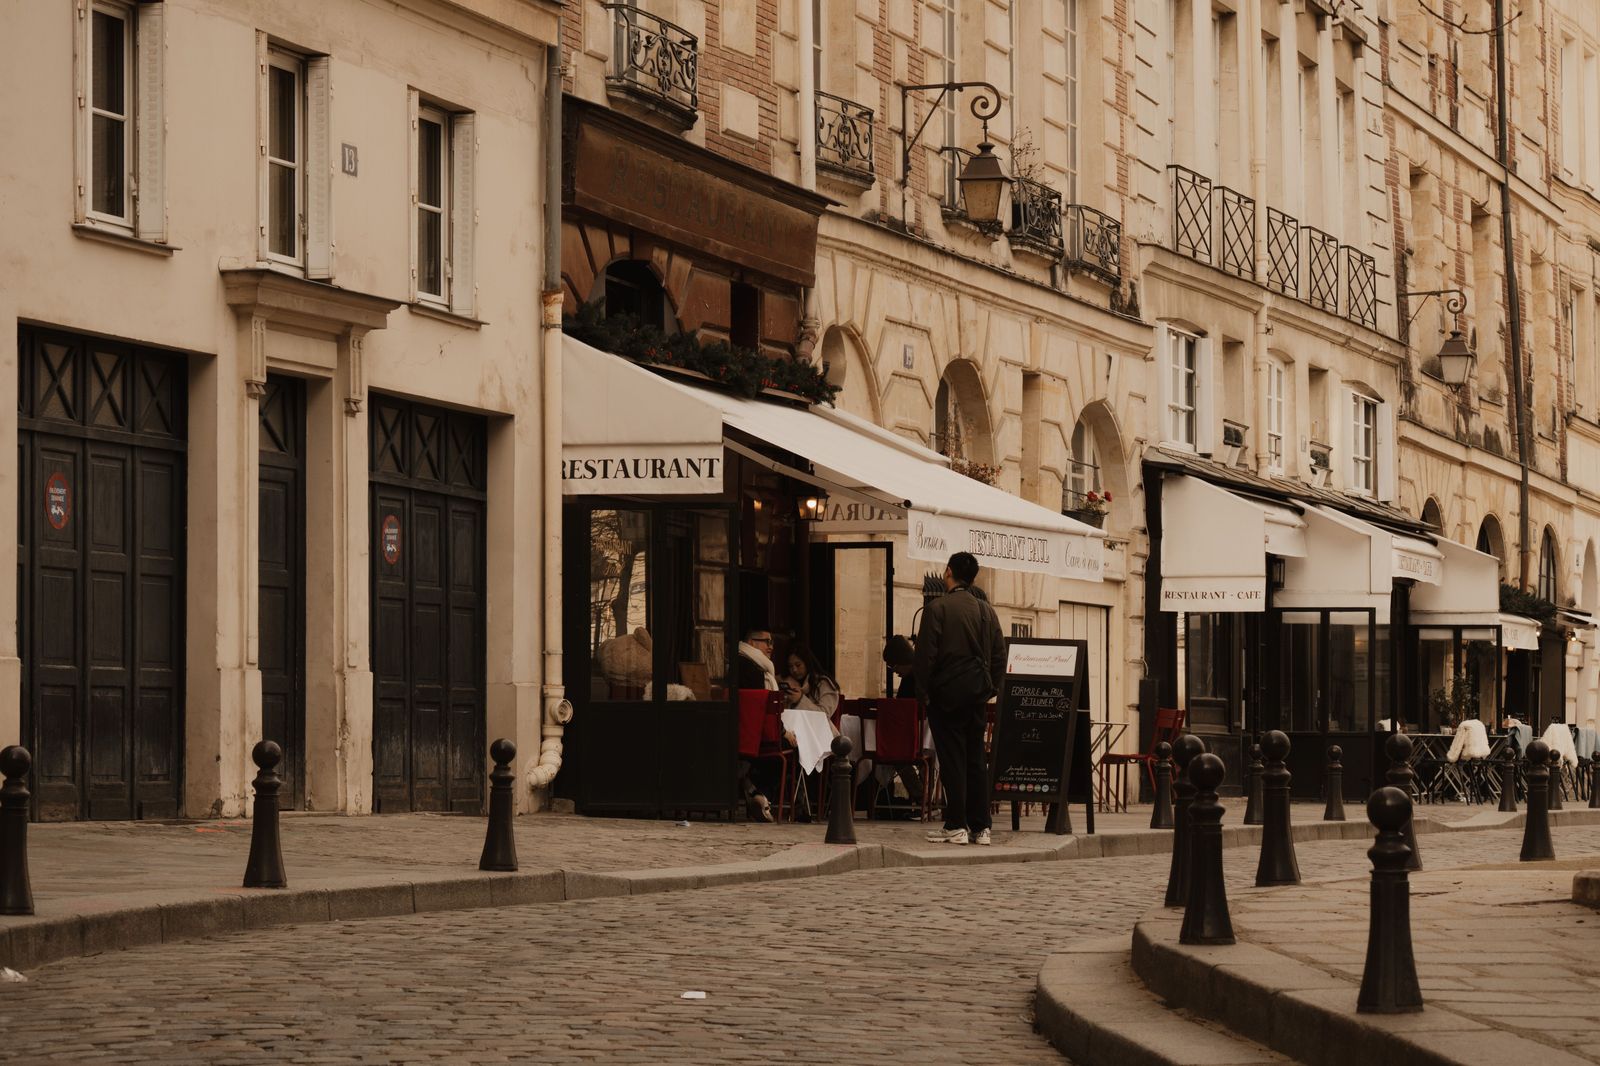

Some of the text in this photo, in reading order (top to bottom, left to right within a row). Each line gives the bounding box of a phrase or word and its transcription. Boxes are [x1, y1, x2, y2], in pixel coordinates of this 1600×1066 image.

[344, 147, 355, 173] 13
[608, 144, 784, 248] RESTAURAN
[969, 529, 1049, 564] RESTAURANT PAUL
[1165, 590, 1226, 600] RESTAURANT
[1014, 710, 1037, 719] PLAT
